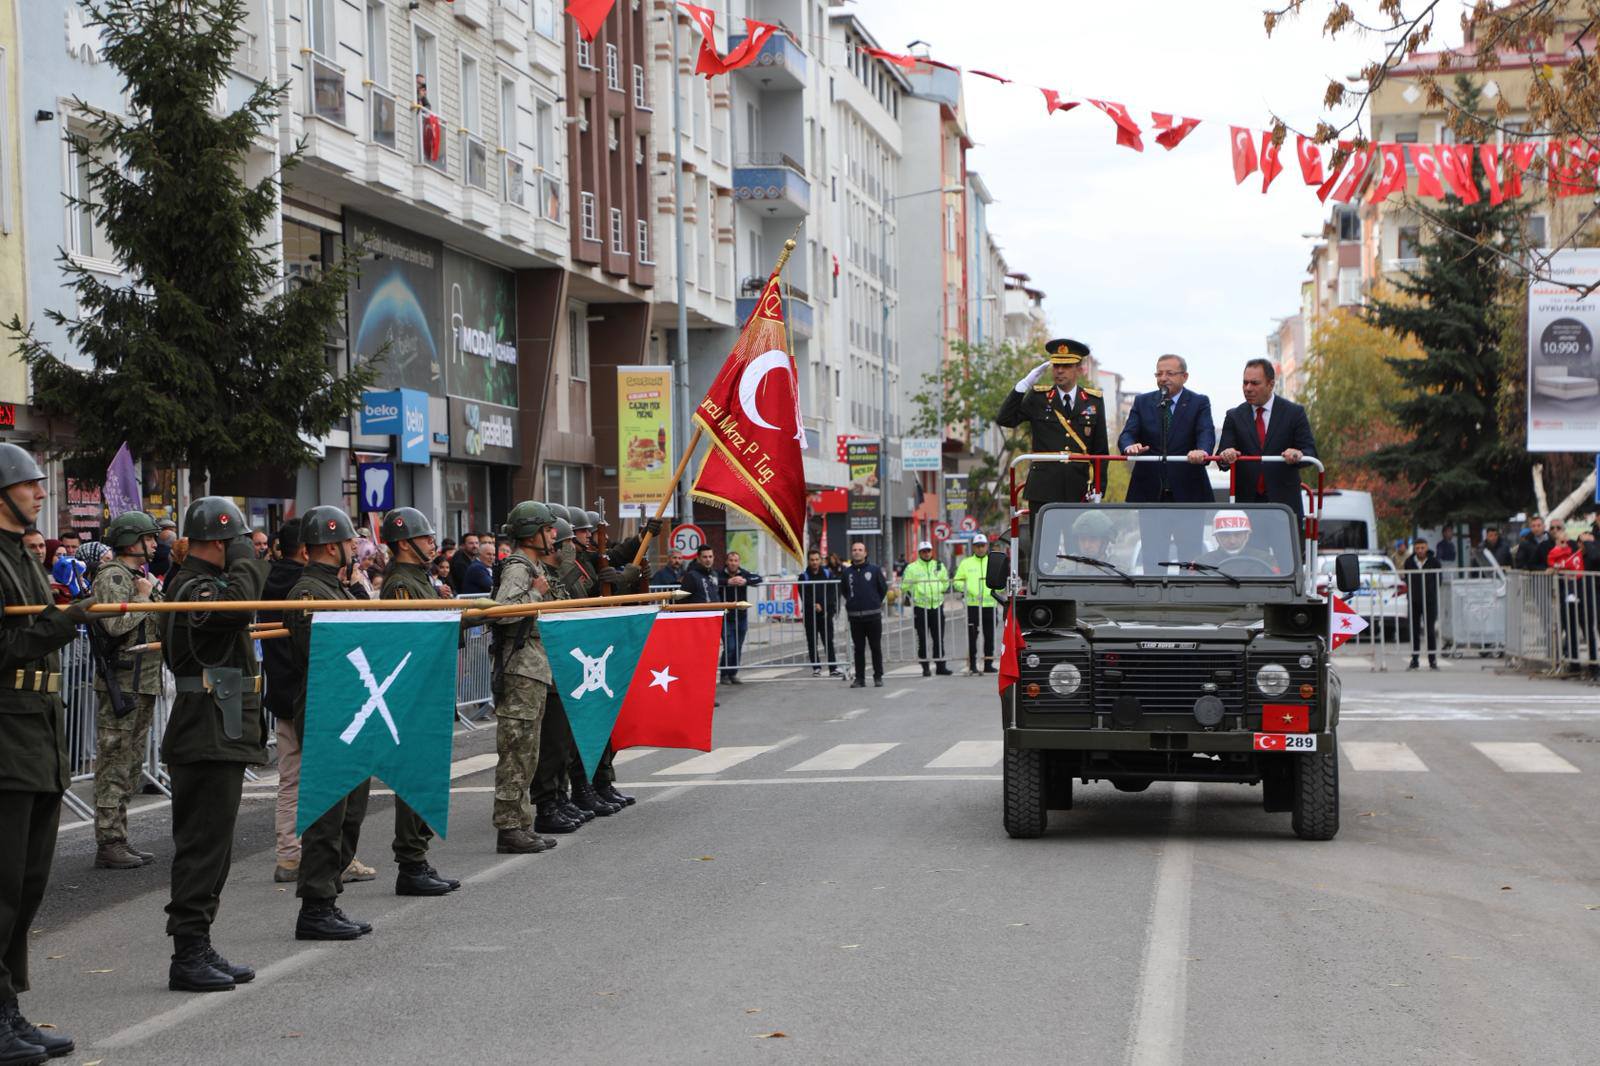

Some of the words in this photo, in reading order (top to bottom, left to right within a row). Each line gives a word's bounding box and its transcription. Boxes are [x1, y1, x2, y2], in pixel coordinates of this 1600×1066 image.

[1538, 304, 1563, 312] UYKU
[1543, 341, 1579, 354] 10.990
[365, 404, 398, 416] beko
[406, 405, 424, 433] beko
[742, 442, 760, 461] P.
[676, 534, 700, 551] 50
[1286, 736, 1314, 748] 289
